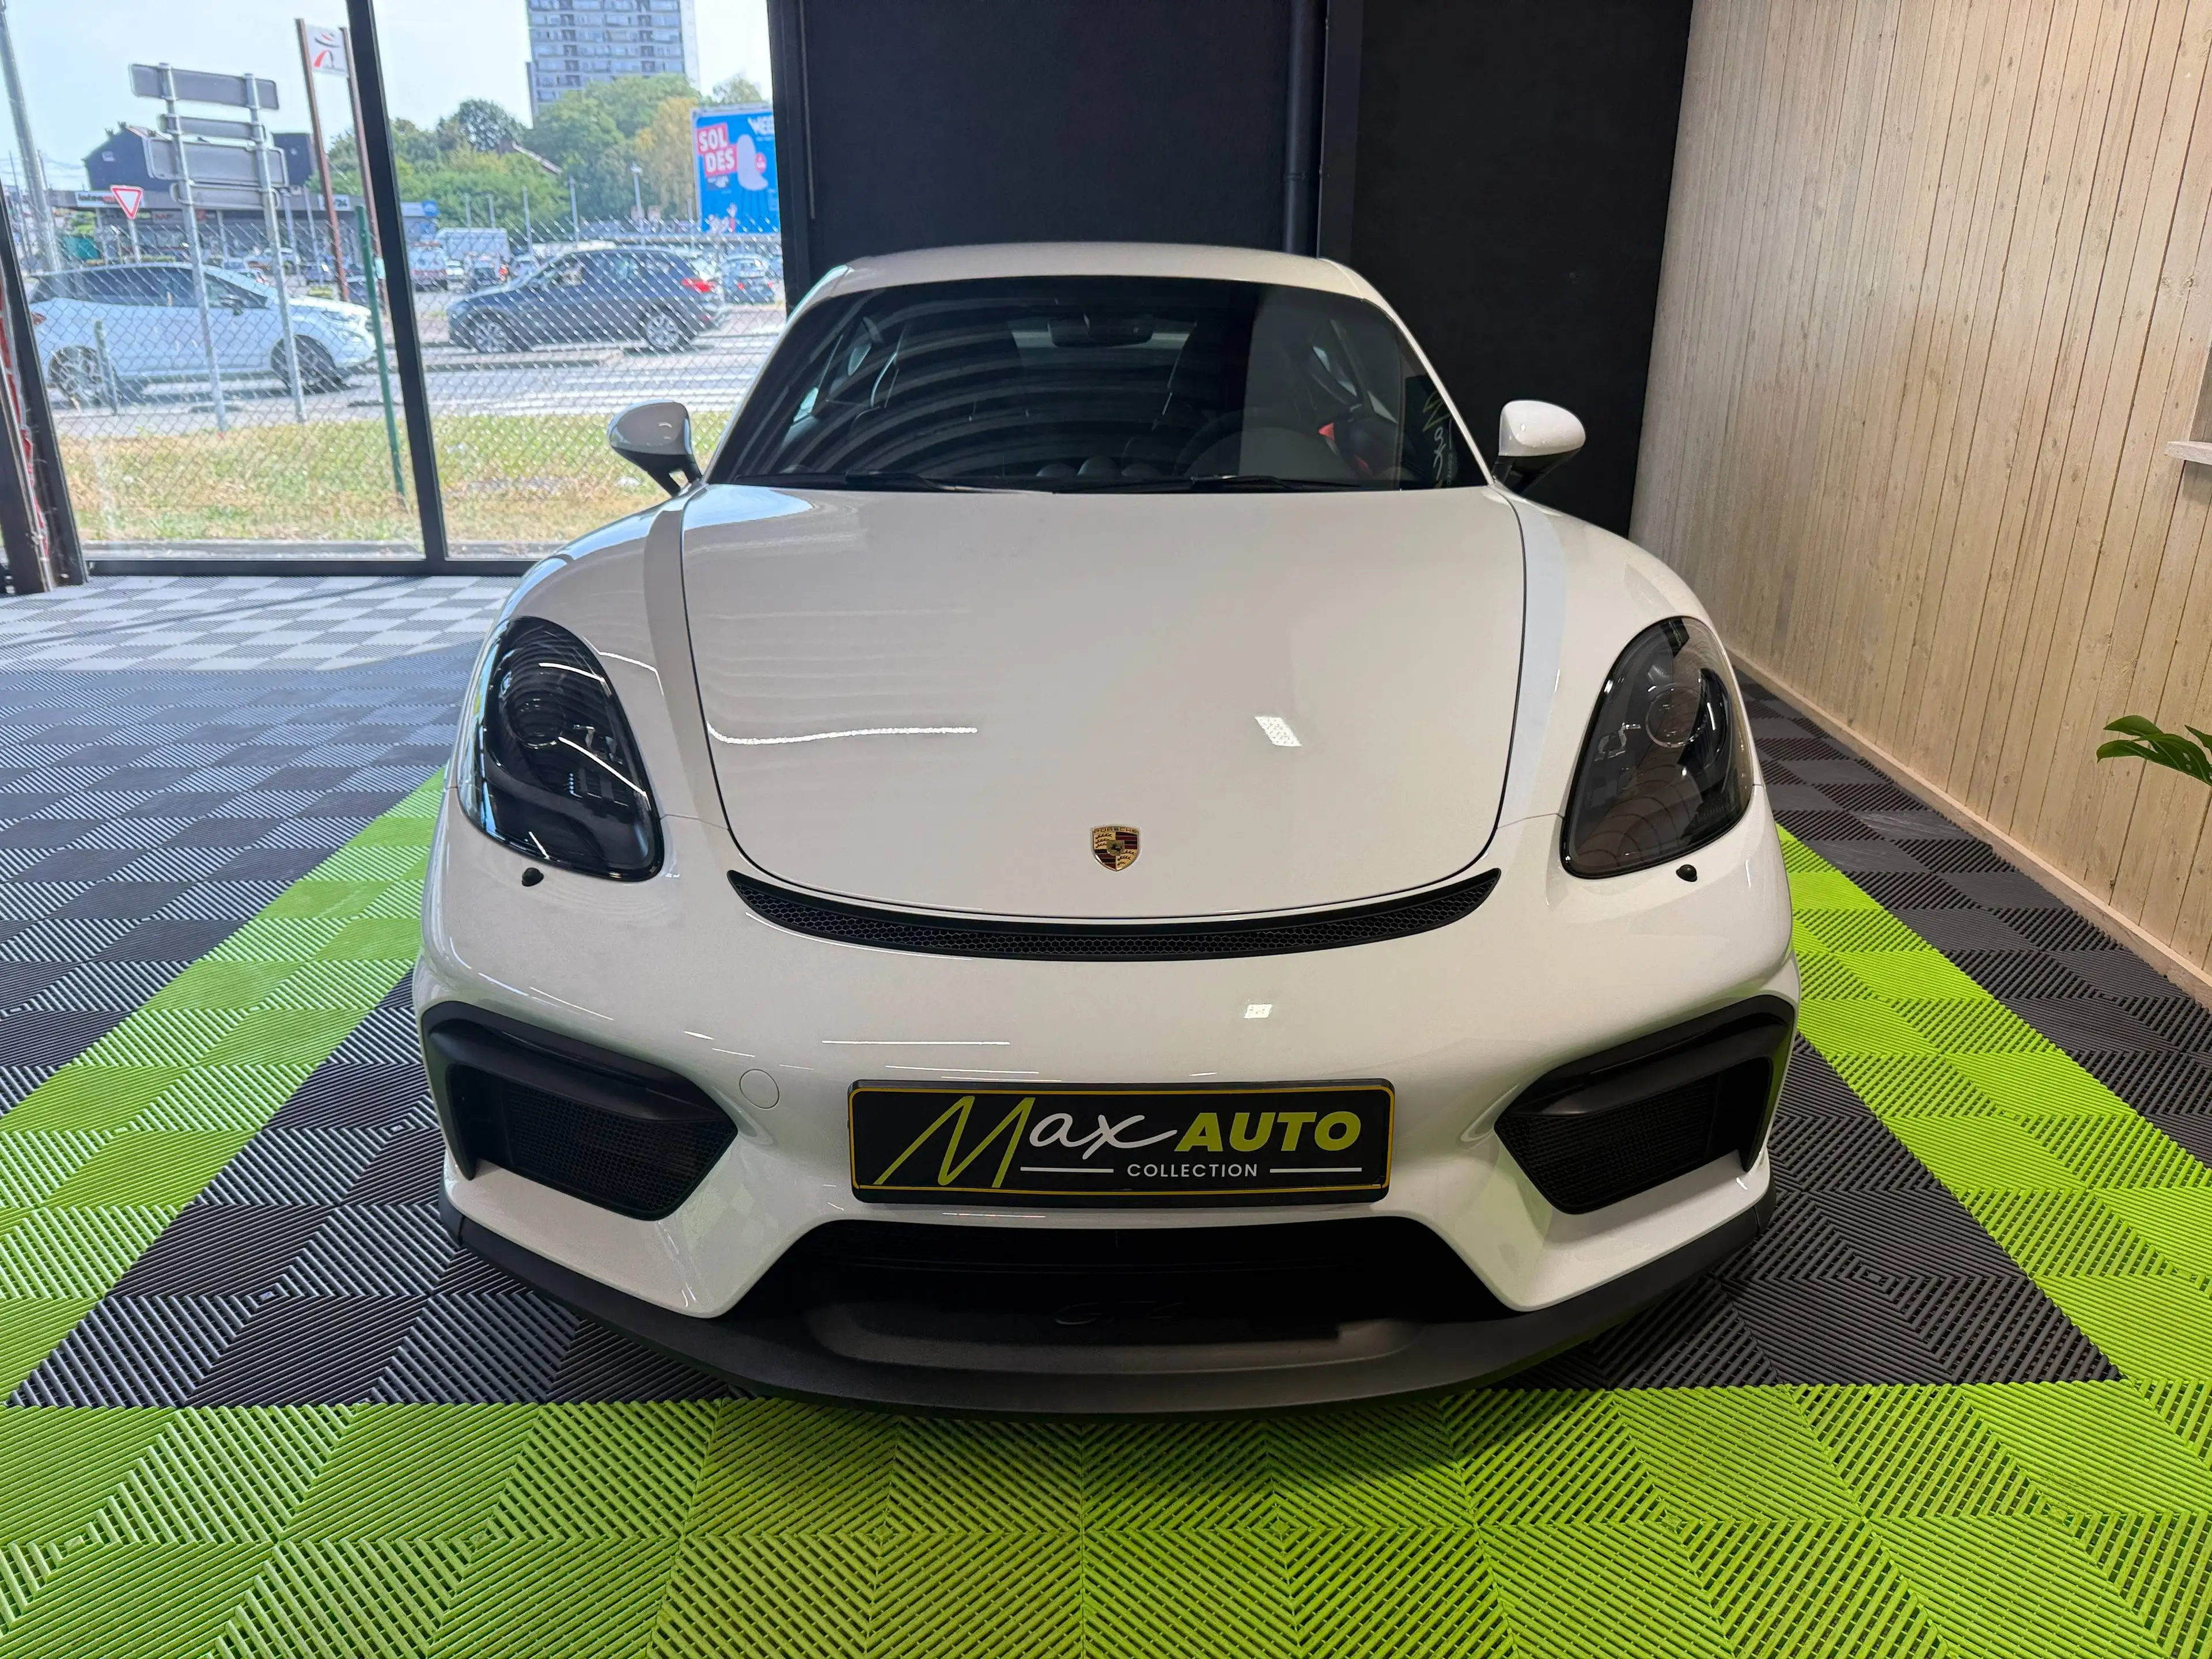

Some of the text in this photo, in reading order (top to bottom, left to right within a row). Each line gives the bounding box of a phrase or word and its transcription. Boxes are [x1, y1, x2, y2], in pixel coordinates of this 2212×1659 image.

[699, 127, 728, 151] SOL
[705, 148, 735, 173] DES
[873, 1095, 1361, 1188] Max AUTO
[1127, 1160, 1259, 1179] COLLECTION
